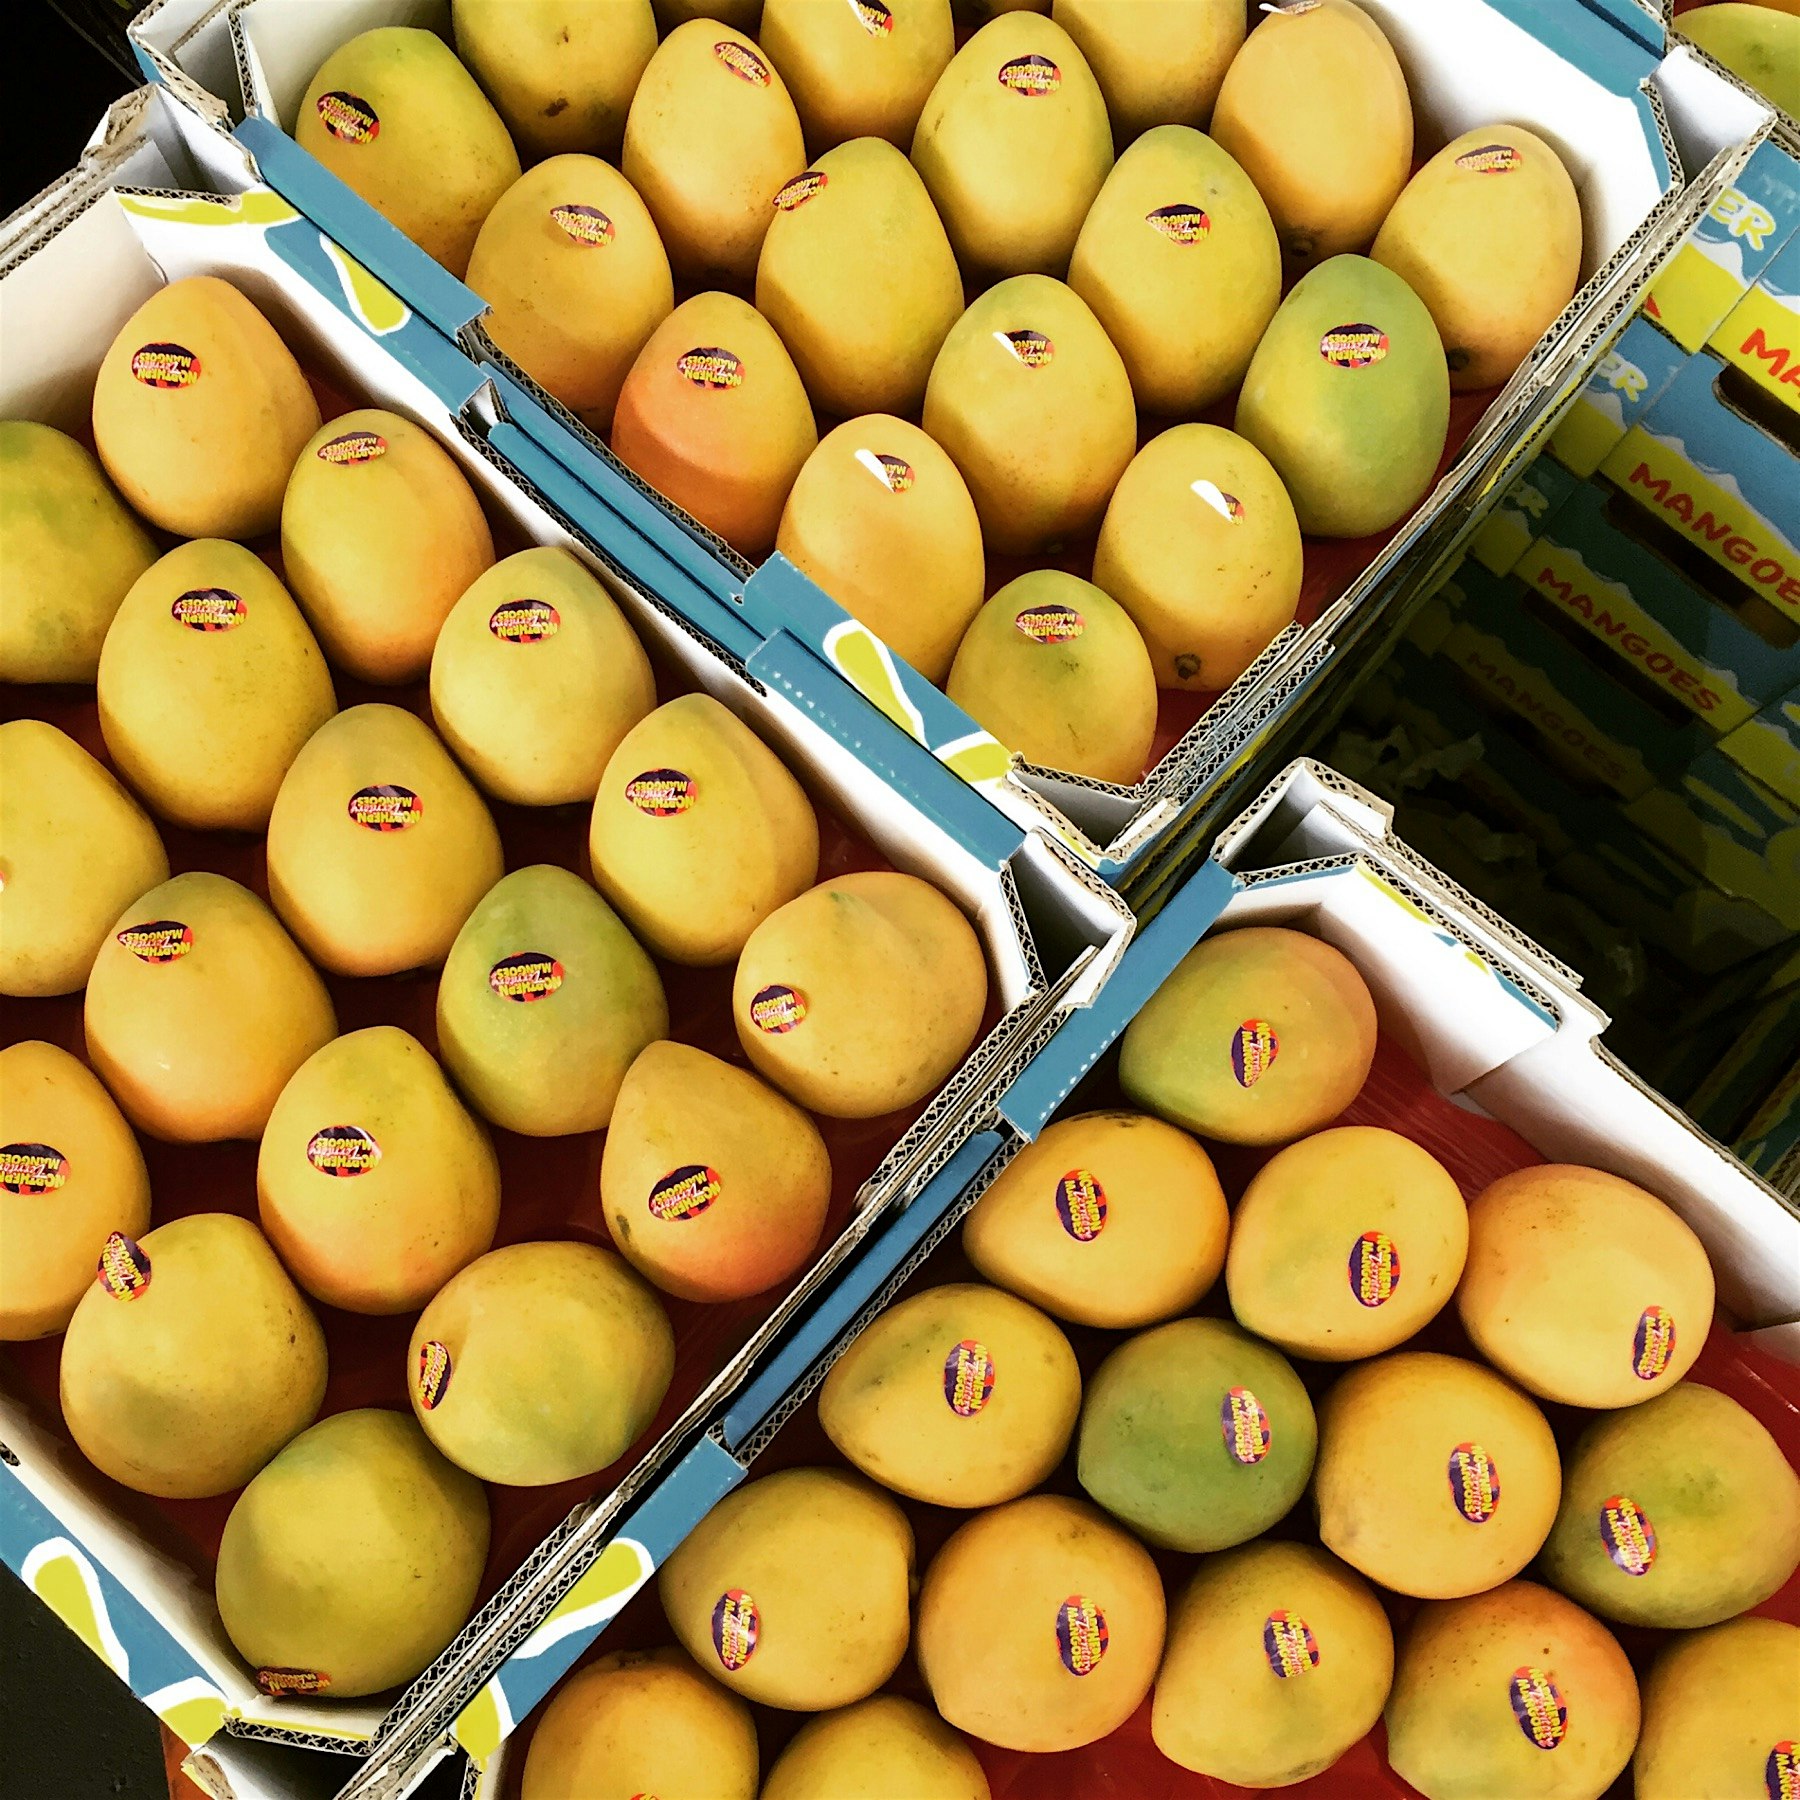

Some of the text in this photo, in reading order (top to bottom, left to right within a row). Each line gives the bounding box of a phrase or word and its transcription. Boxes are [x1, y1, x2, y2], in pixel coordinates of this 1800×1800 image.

[1628, 461, 1800, 605] MANGOE
[1537, 567, 1723, 711] MANGOES
[1466, 651, 1629, 780] MANGOES
